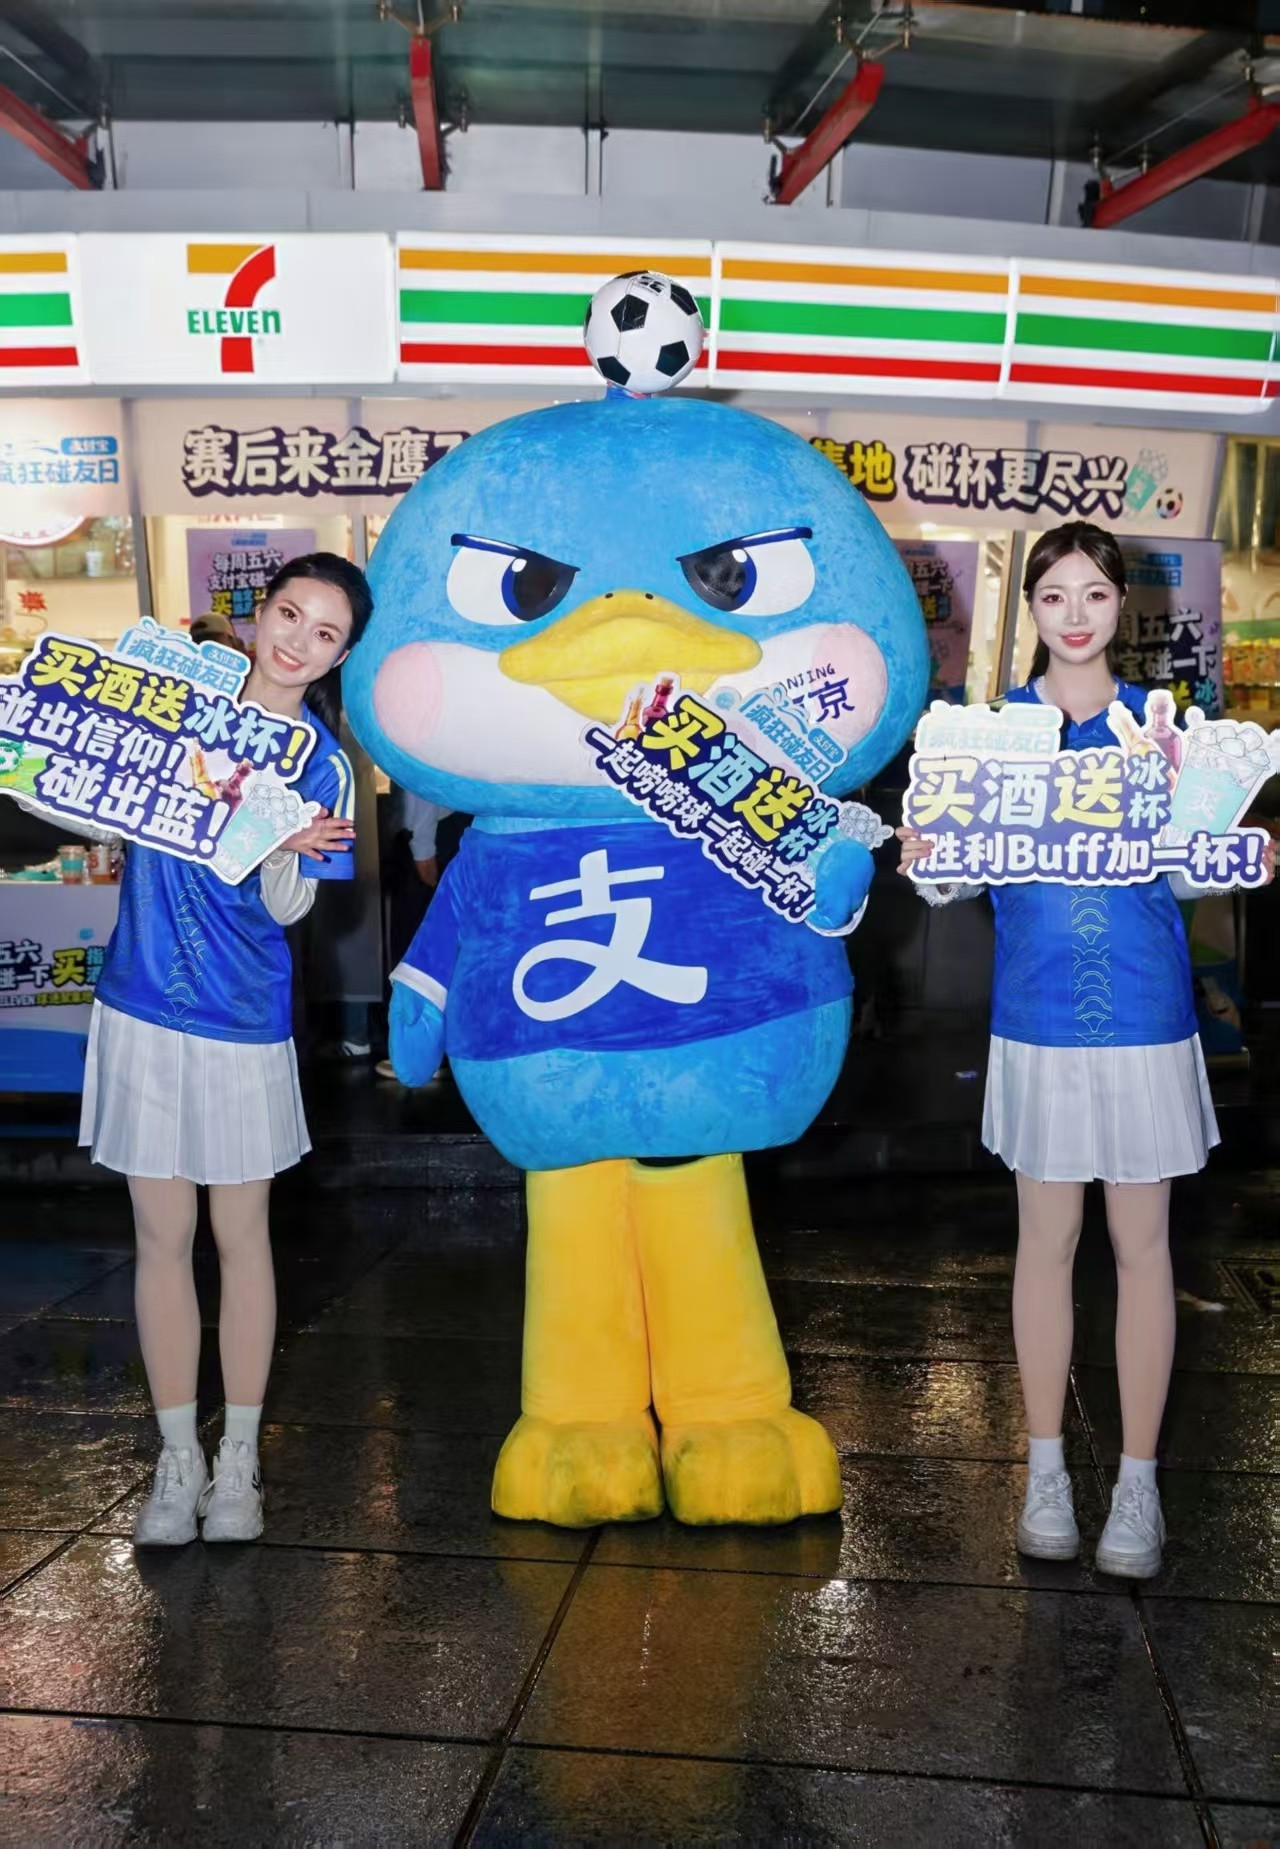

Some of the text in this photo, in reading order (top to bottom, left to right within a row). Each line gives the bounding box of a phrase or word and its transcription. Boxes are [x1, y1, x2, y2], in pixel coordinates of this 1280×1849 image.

[185, 428, 449, 489] 赛后来金鹰
[908, 444, 1127, 512] 碰杯更尽兴
[30, 639, 306, 771] 买酒送冰杯!
[126, 638, 242, 697] 疯狂碰友日
[792, 677, 856, 723] 京
[0, 687, 185, 780] 碰出信仰!
[744, 704, 831, 783] 疯狂碰友日
[39, 755, 231, 855] 碰出蓝!
[917, 831, 1265, 877] 胜利Buff加一杯!
